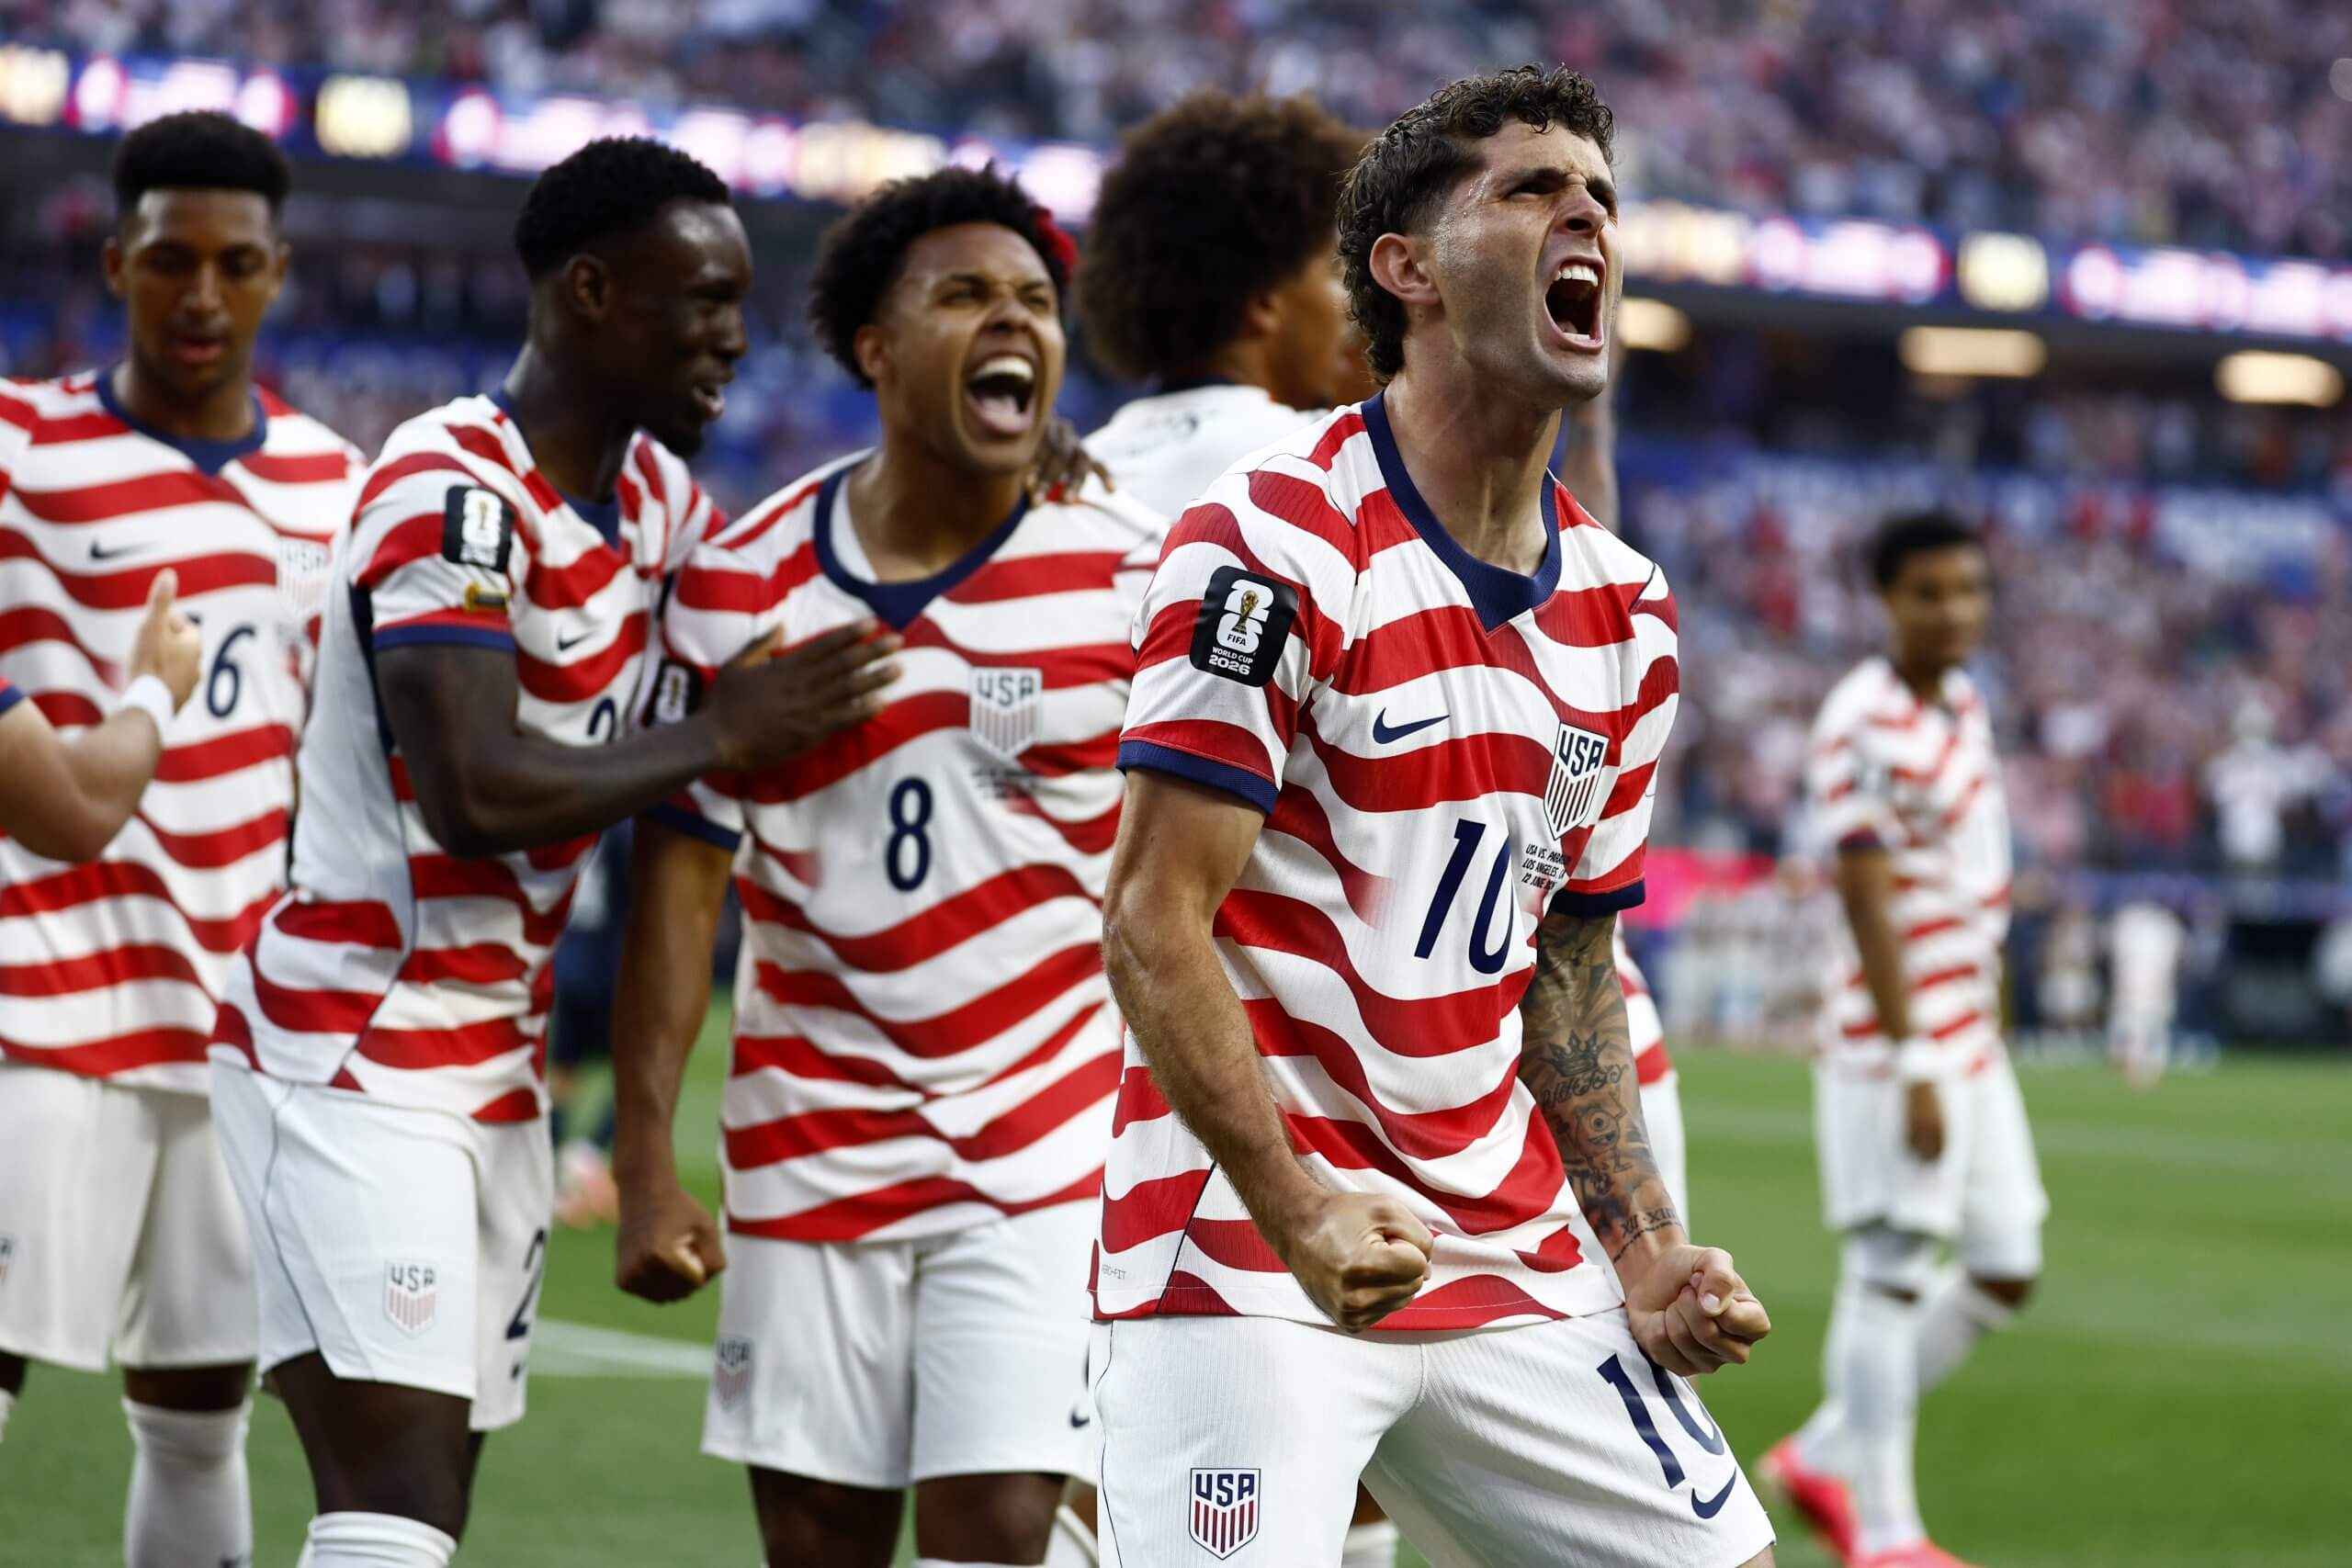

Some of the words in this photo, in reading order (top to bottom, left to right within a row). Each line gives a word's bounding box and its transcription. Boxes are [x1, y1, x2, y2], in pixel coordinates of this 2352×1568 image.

[1212, 646, 1238, 660] WORLD
[1238, 654, 1254, 665] CUP
[1227, 634, 1248, 647] FIFA
[187, 613, 256, 718] 6
[1208, 654, 1251, 676] 2026
[978, 675, 1035, 707] USA
[1558, 729, 1605, 777] USA
[886, 775, 934, 893] 8
[1525, 843, 1538, 855] USA
[1521, 858, 1537, 870] LOS
[1413, 818, 1515, 975] 10
[390, 1264, 436, 1292] USA
[1596, 1337, 1725, 1490] 10
[1195, 1472, 1256, 1507] USA
